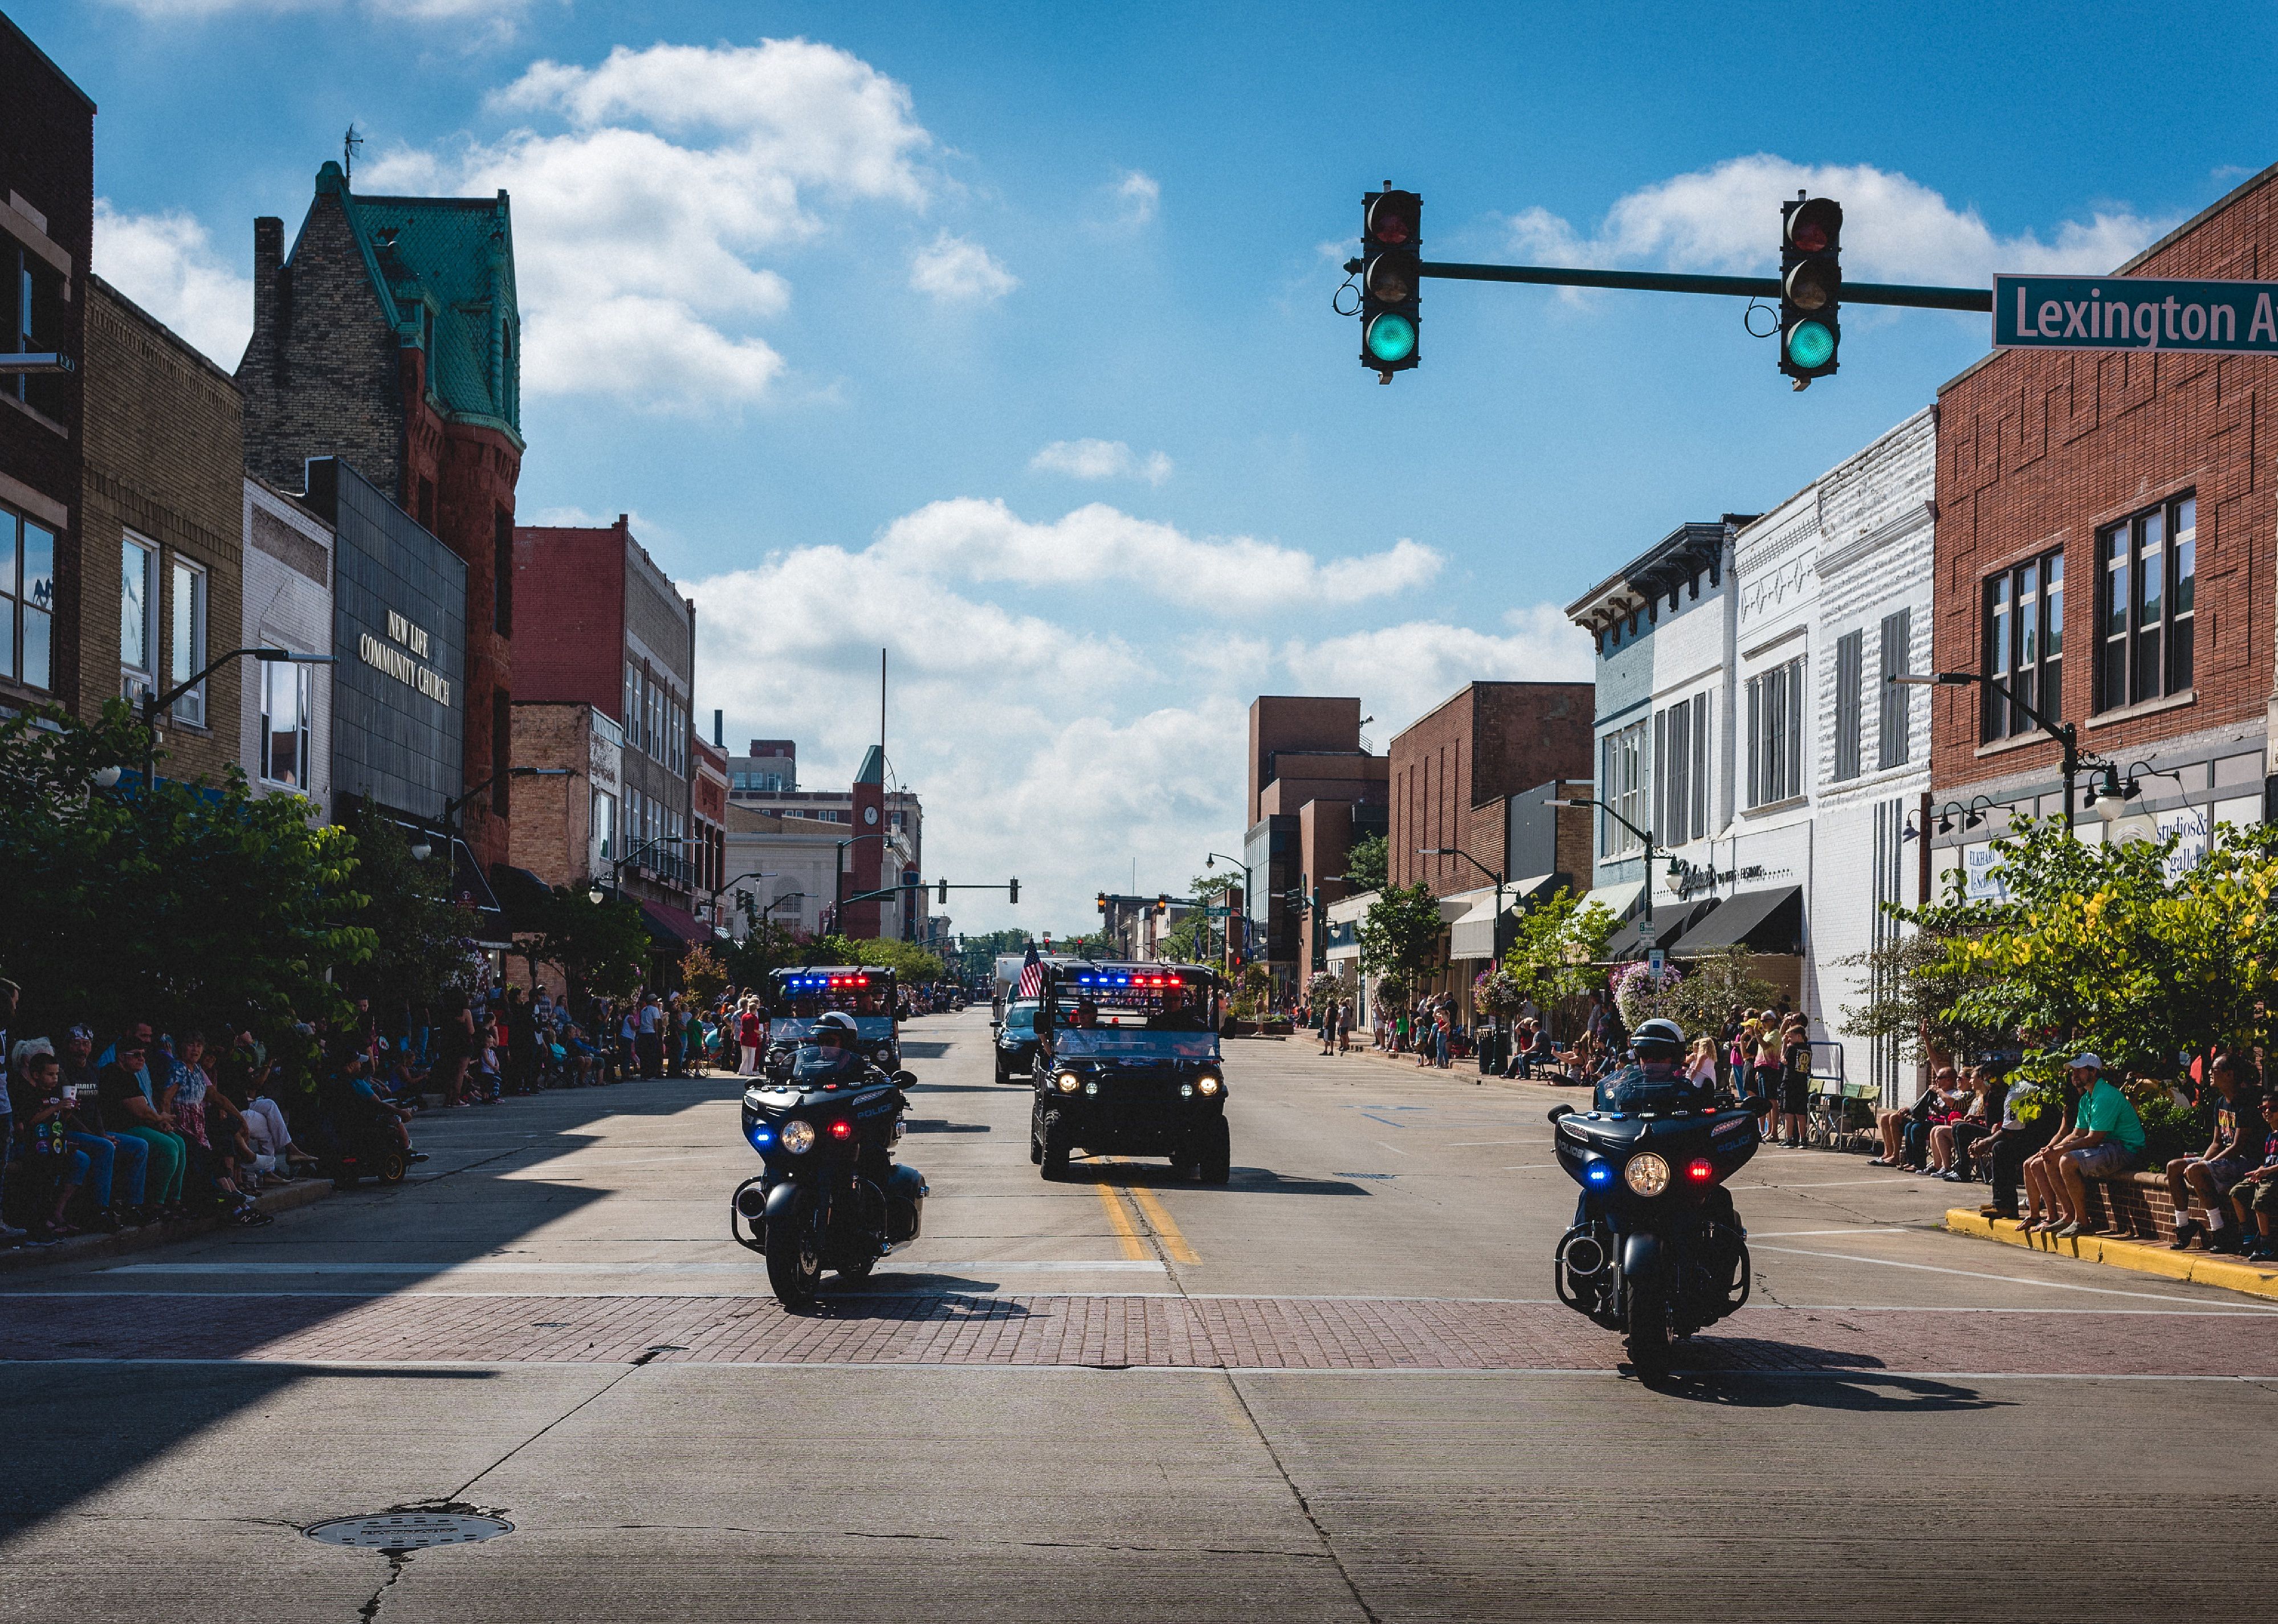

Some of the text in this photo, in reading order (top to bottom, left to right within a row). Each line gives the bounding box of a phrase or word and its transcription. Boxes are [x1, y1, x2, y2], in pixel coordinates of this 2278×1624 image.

[2016, 286, 2278, 349] Lexington A
[388, 609, 429, 659] NEW LIFE
[359, 633, 450, 707] COMMUNITY CHURCH
[2169, 848, 2204, 879] galler
[857, 1103, 893, 1119] POLICE
[1558, 1139, 1584, 1158] POLICE
